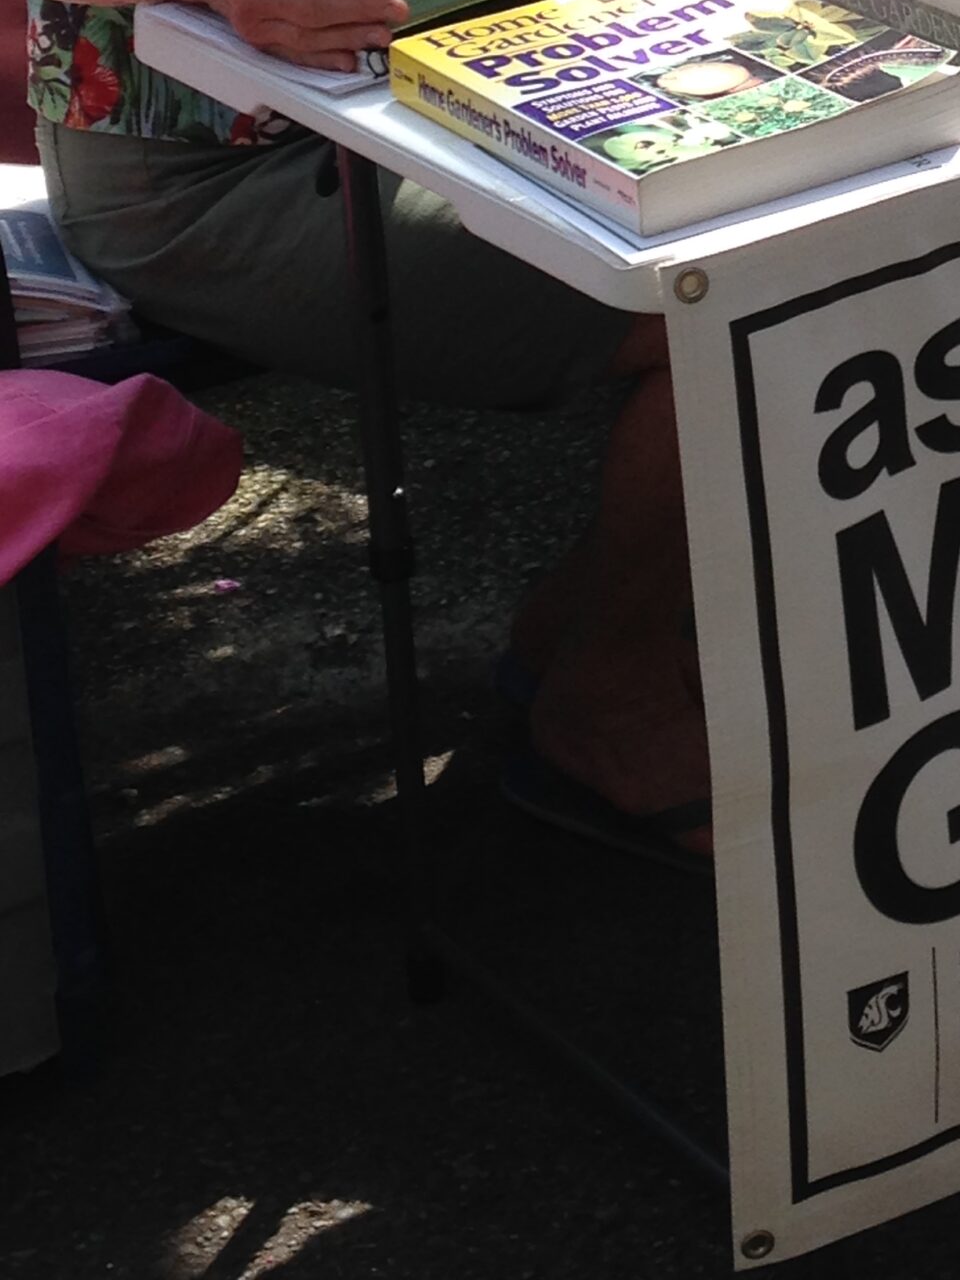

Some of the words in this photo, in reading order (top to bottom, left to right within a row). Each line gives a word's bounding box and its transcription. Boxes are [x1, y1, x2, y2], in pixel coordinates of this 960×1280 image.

[421, 8, 561, 50] Home
[503, 28, 714, 95] Solver
[417, 73, 444, 111] Home
[446, 90, 502, 143] Gardener's
[503, 119, 550, 169] Problem
[551, 145, 588, 188] Solver
